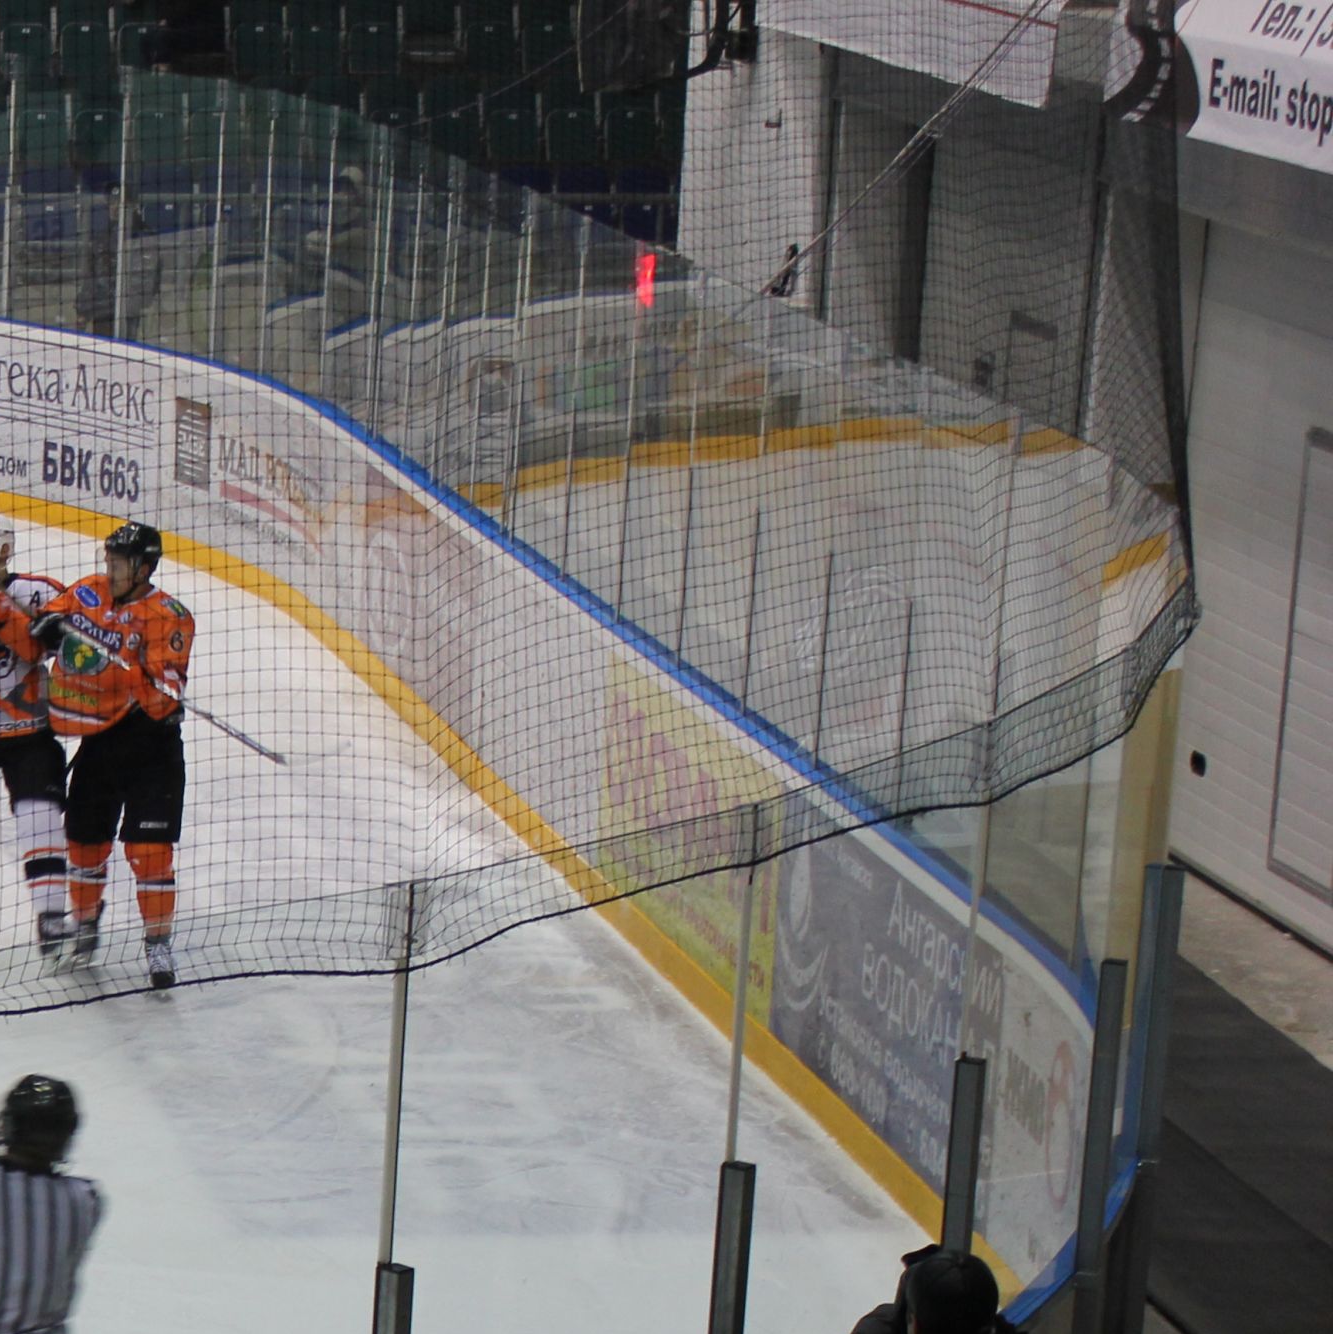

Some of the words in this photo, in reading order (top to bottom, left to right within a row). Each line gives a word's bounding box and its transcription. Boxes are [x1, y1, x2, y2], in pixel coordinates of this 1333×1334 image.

[1209, 58, 1281, 122] E-mail:
[42, 439, 93, 491] БВК
[99, 453, 140, 503] 663
